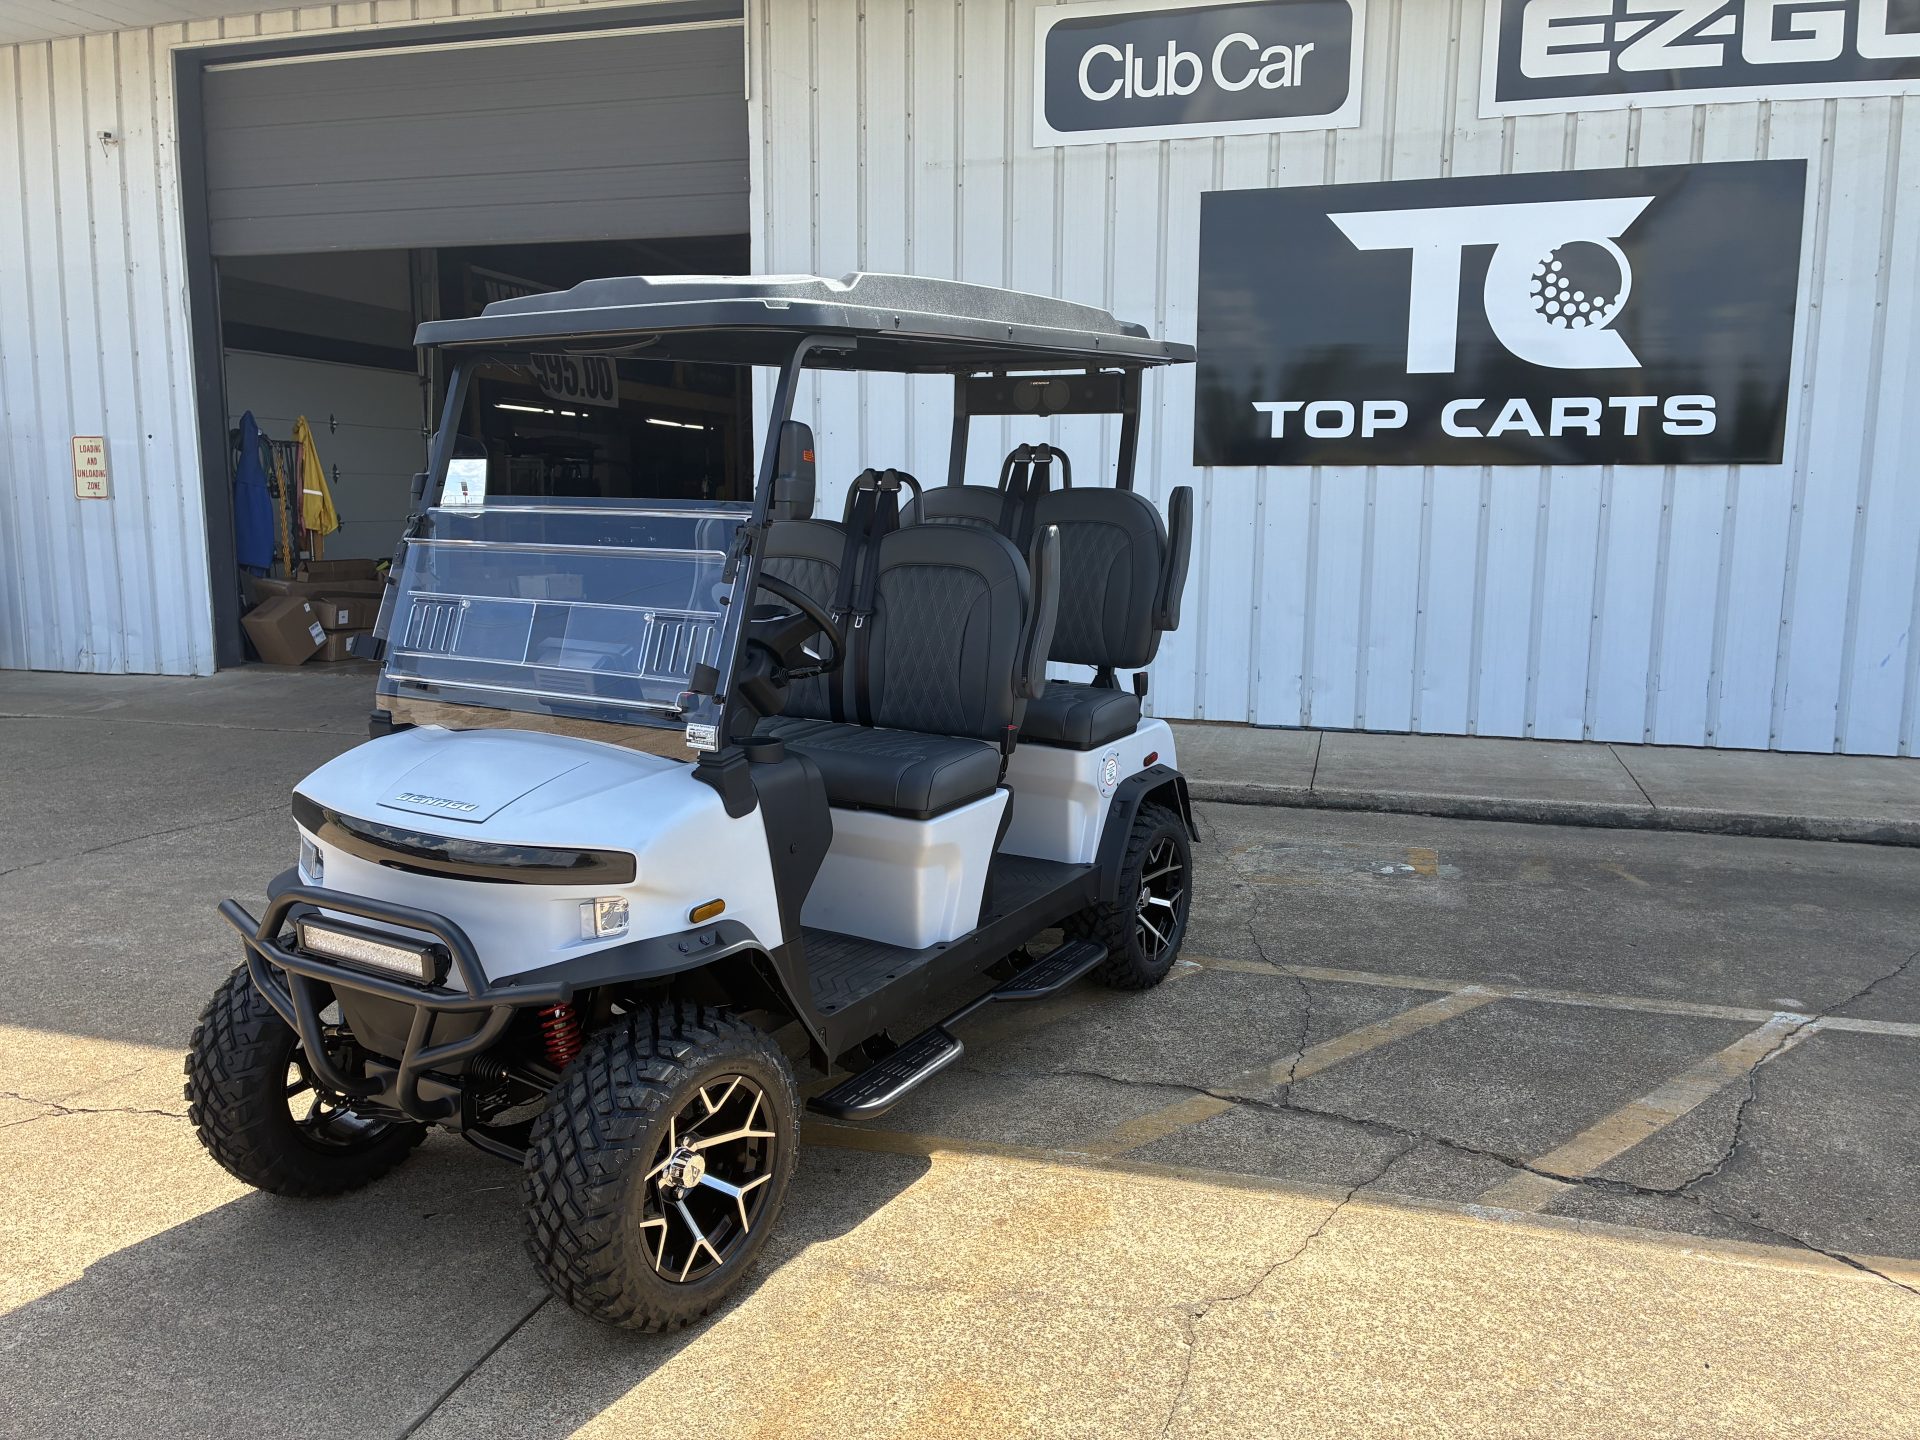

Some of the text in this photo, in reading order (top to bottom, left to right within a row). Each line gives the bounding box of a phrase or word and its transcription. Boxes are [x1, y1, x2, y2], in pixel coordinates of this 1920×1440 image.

[1078, 32, 1315, 101] Club Car
[1252, 394, 1717, 439] TOP CARTS
[79, 445, 102, 453] LOADING
[86, 457, 98, 466] AND
[77, 469, 106, 478] UNLOADING
[87, 481, 101, 490] ZONE
